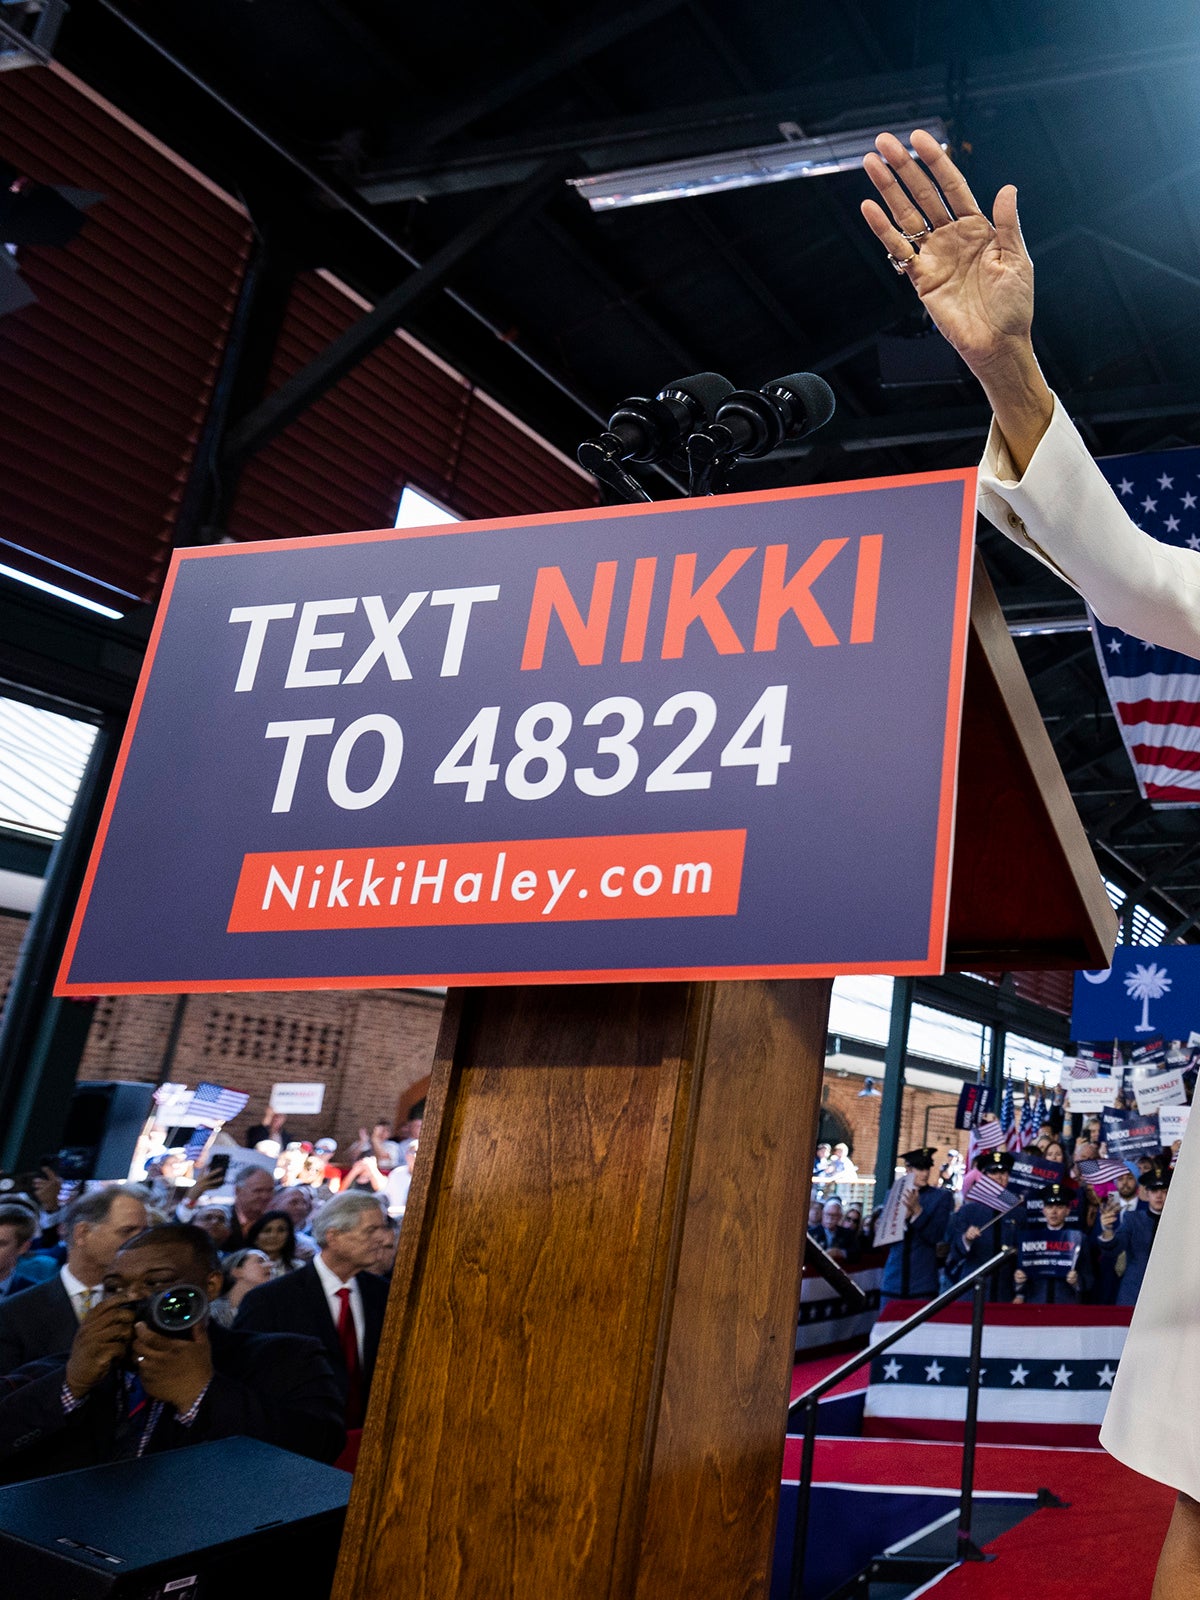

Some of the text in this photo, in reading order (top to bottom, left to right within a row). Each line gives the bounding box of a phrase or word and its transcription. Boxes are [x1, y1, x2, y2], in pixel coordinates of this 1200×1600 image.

[228, 534, 884, 692] TEXT NIKKI
[265, 685, 792, 813] TO 48324
[261, 852, 712, 914] NikkiHaley.com
